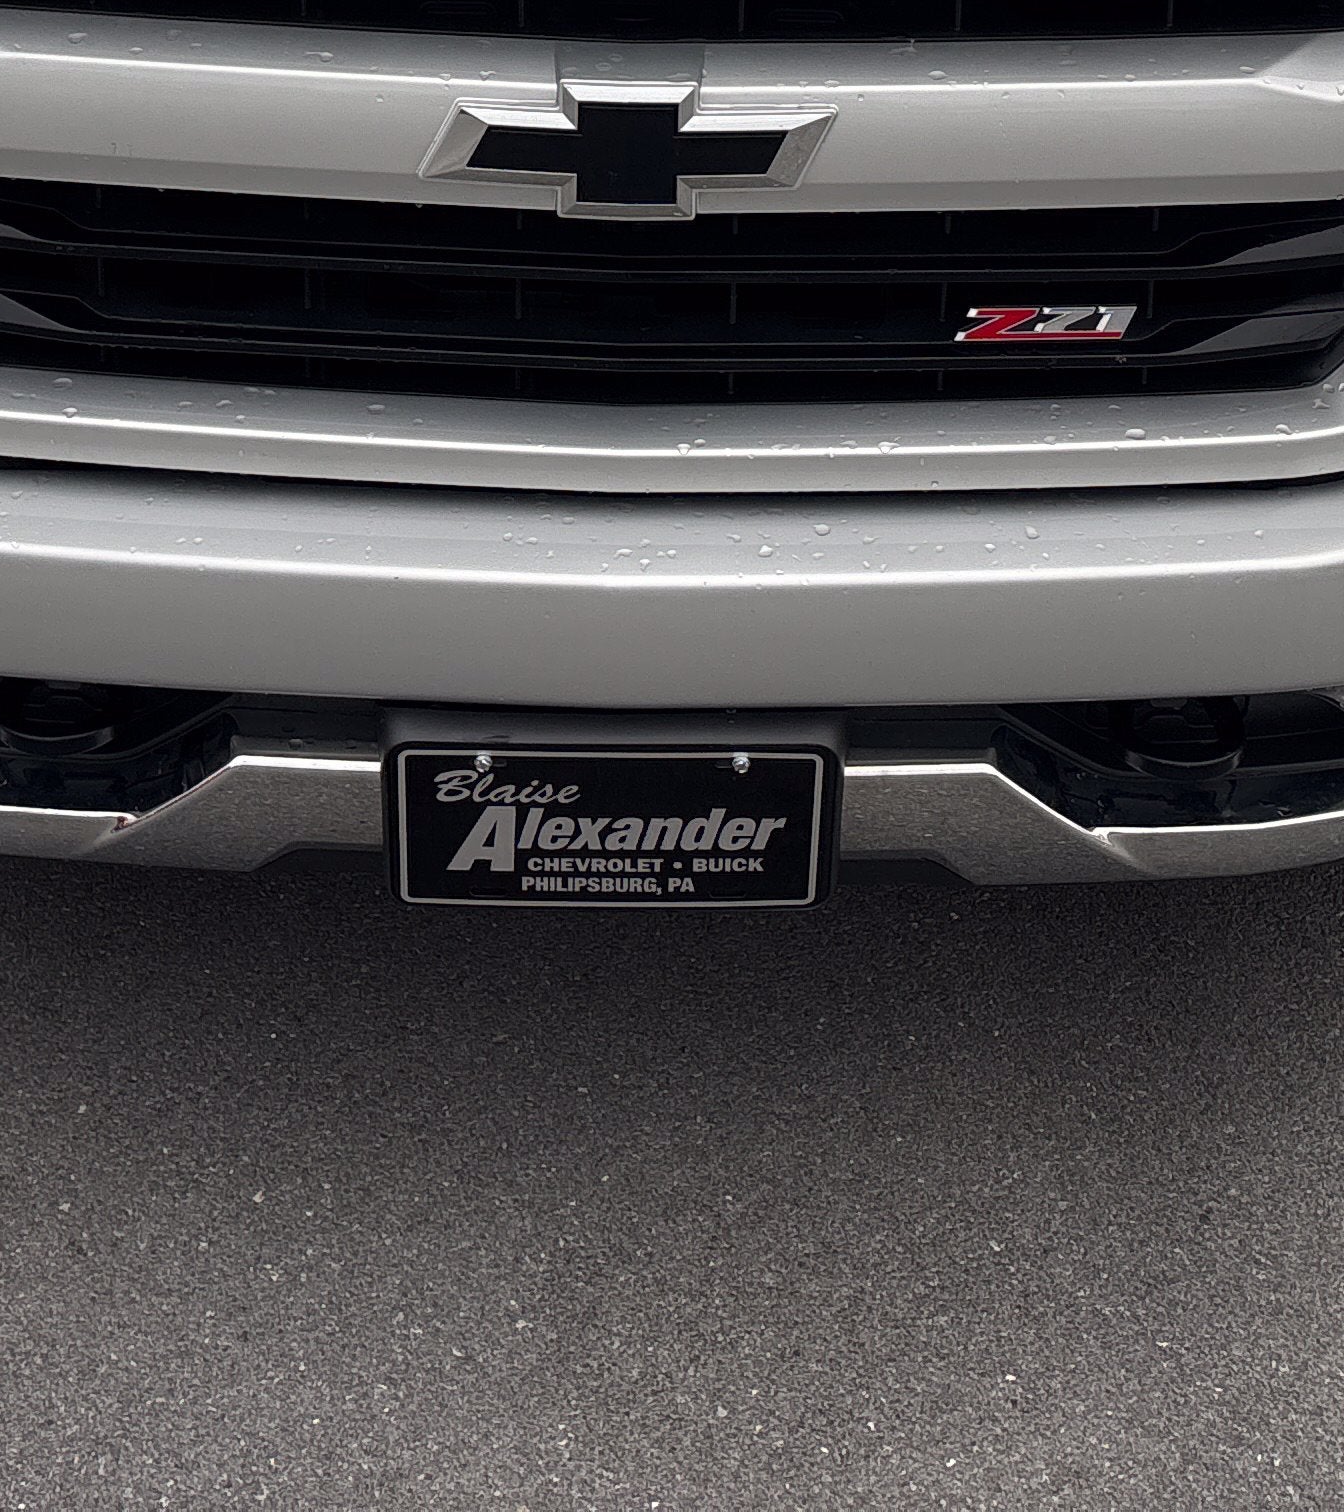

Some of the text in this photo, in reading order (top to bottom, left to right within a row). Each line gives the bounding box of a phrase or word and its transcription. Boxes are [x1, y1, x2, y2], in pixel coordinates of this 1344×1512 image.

[954, 305, 1138, 342] Z71
[433, 769, 581, 804] Blaise
[446, 805, 788, 872] Alexander
[527, 857, 765, 873] CHEVROLET BUICK
[521, 876, 696, 895] PHILIPSBURG, PA
